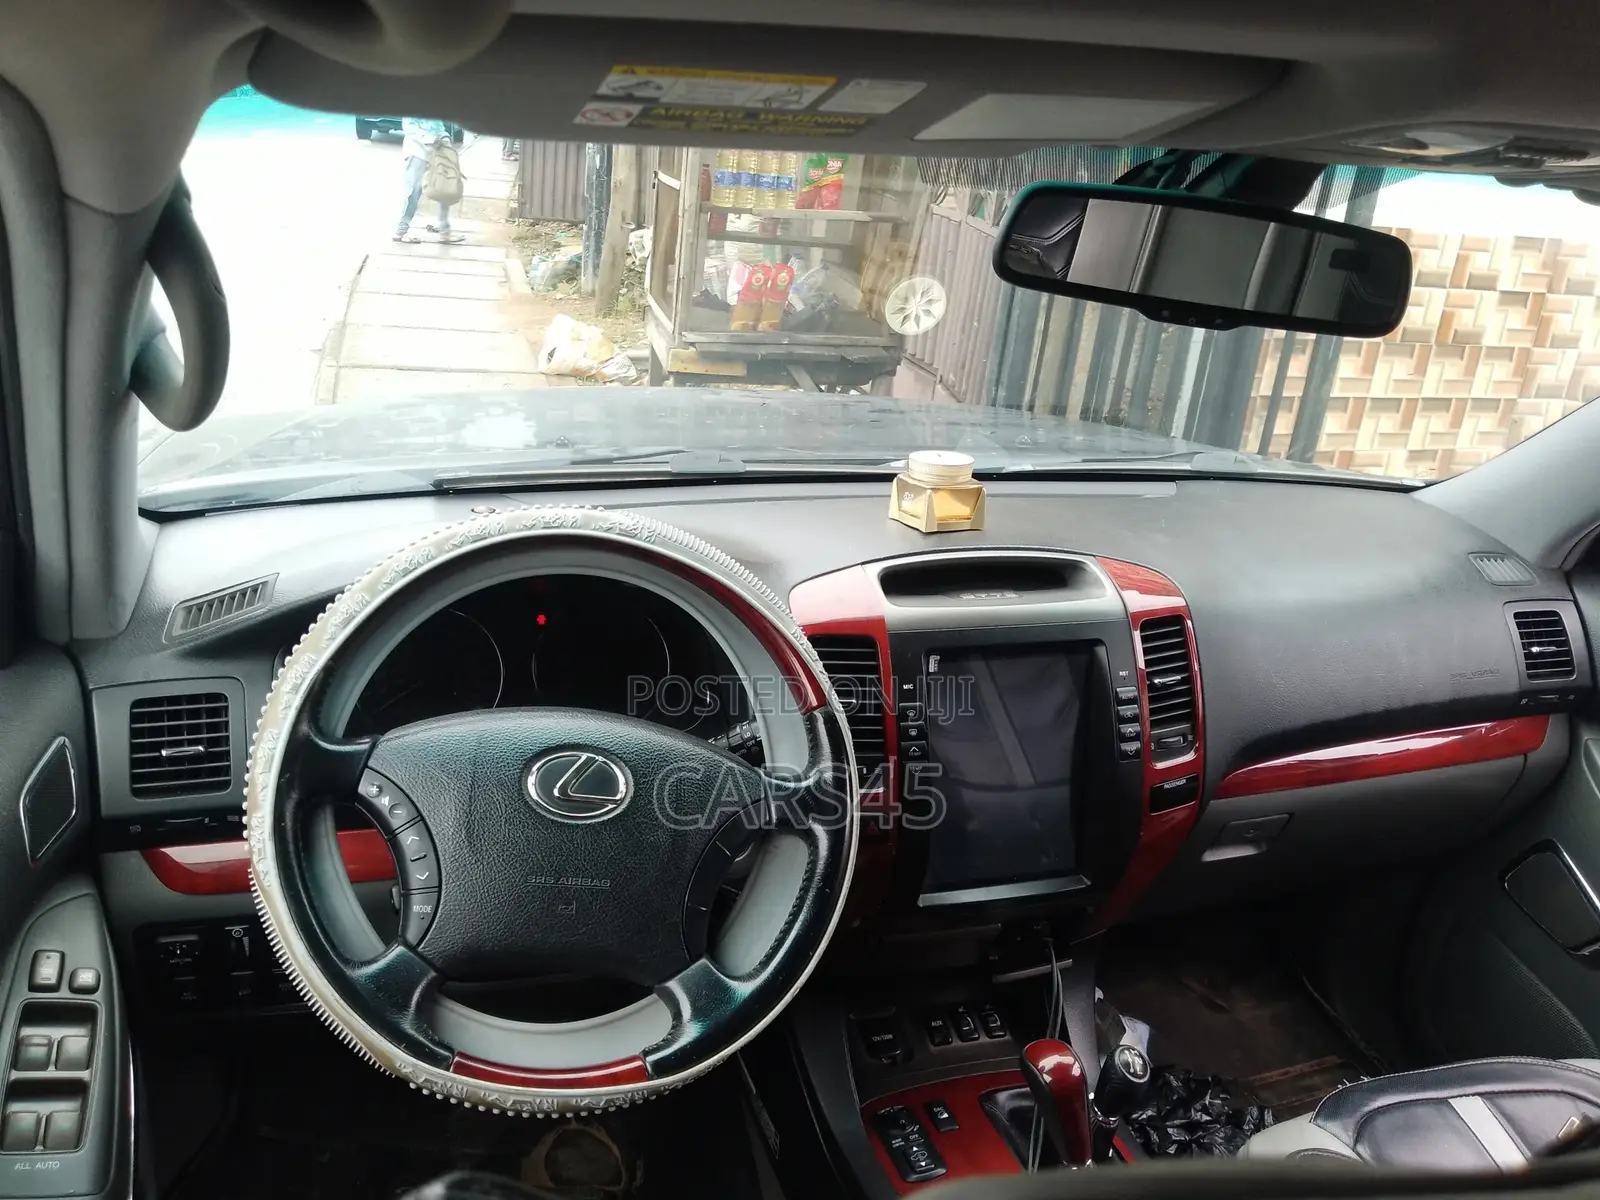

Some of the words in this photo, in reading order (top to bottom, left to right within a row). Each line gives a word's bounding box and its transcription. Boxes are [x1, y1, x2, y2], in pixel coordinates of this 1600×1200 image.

[757, 112, 868, 126] WARNING
[527, 875, 554, 884] SRS
[558, 877, 611, 887] AIRBAG
[413, 905, 433, 913] MODE
[15, 1162, 32, 1170] ALL
[36, 1160, 60, 1170] AUTO
